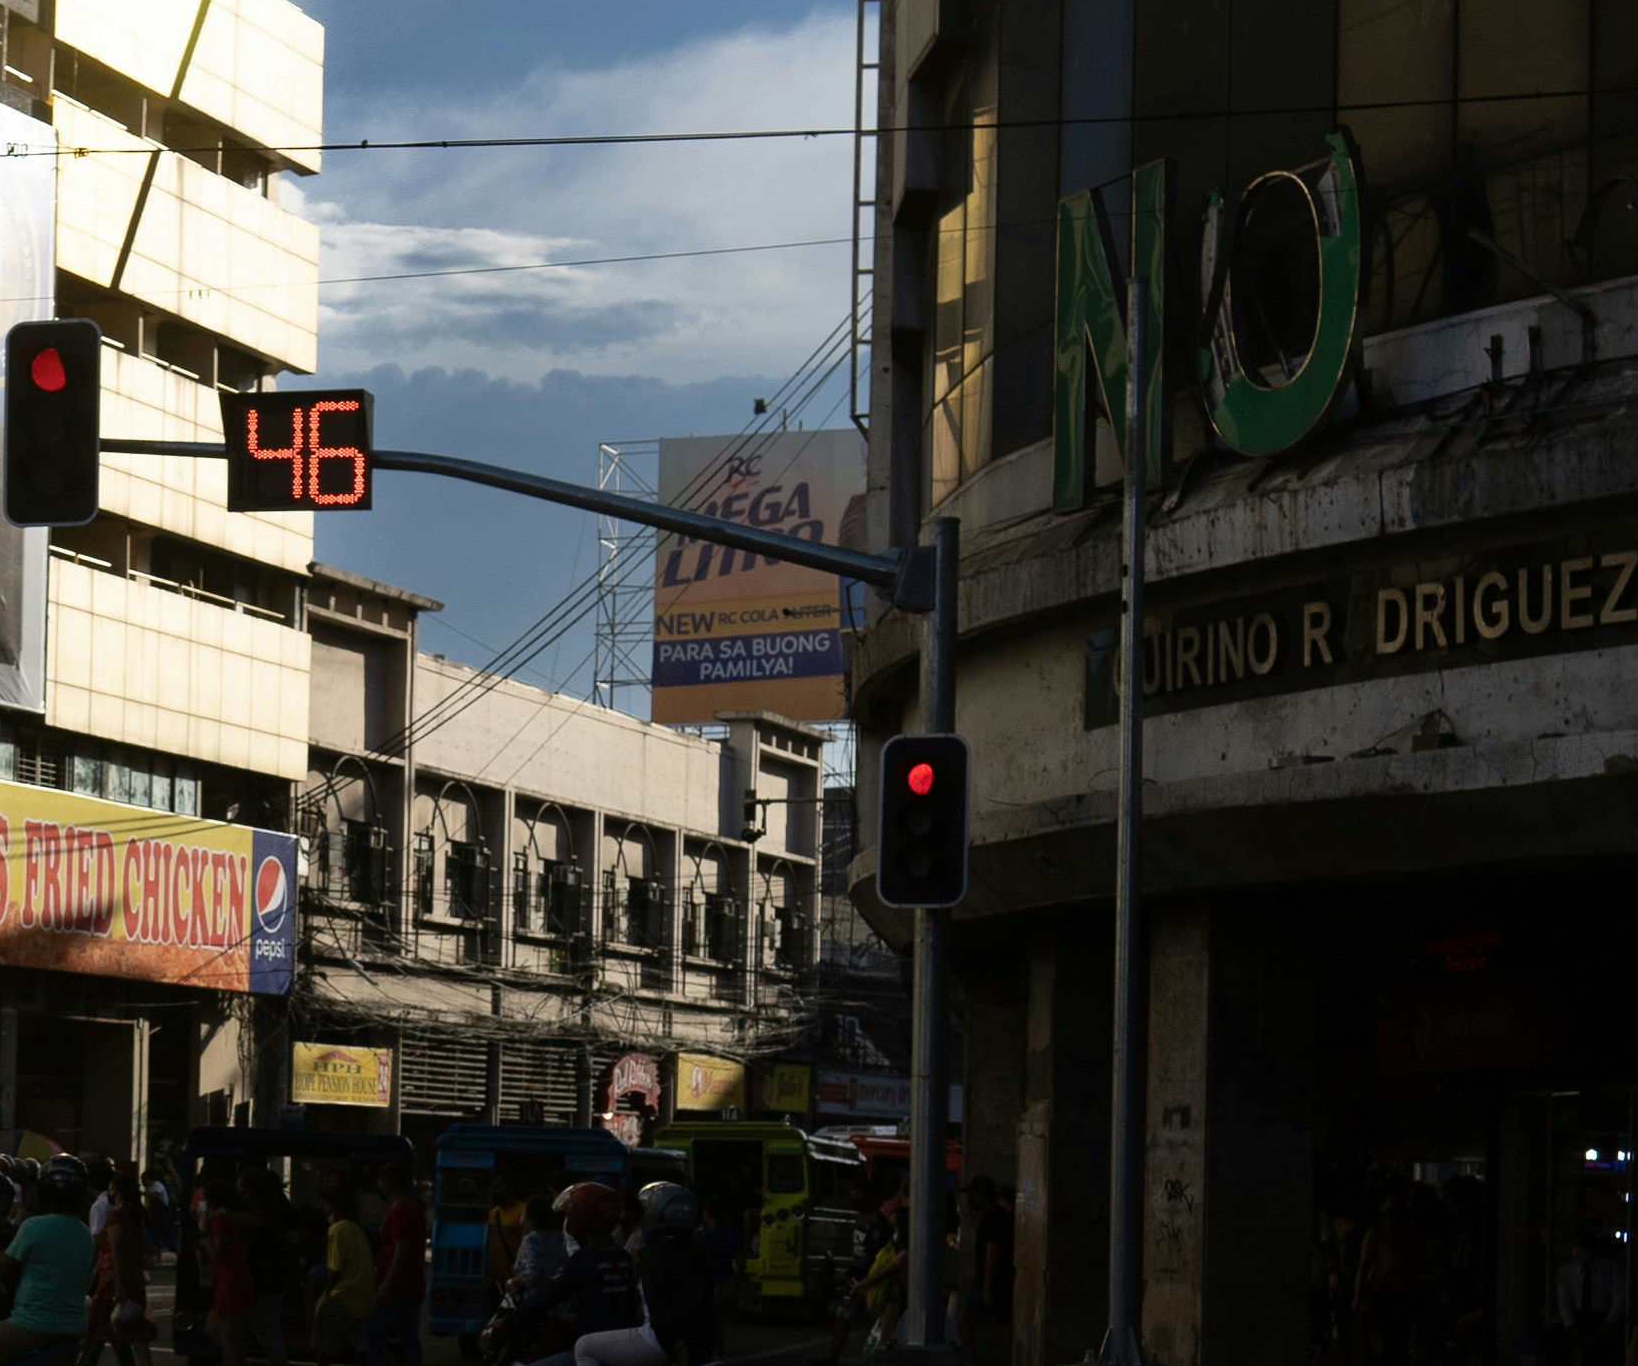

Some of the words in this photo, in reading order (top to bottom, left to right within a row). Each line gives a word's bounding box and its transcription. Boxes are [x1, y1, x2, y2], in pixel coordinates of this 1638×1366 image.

[247, 401, 365, 506] 46
[656, 612, 714, 636] NEW
[719, 612, 738, 626] RC
[740, 610, 779, 624] COLA
[1303, 601, 1333, 668] R
[1376, 550, 1638, 655] DRIGUEZ
[660, 643, 714, 663] PARA
[719, 640, 747, 659] SA
[752, 633, 831, 657] BUONG
[699, 657, 794, 681] PAMILYA!
[20, 819, 114, 935] FRIED
[122, 838, 248, 952] CHICKEN
[255, 937, 286, 962] pepsi
